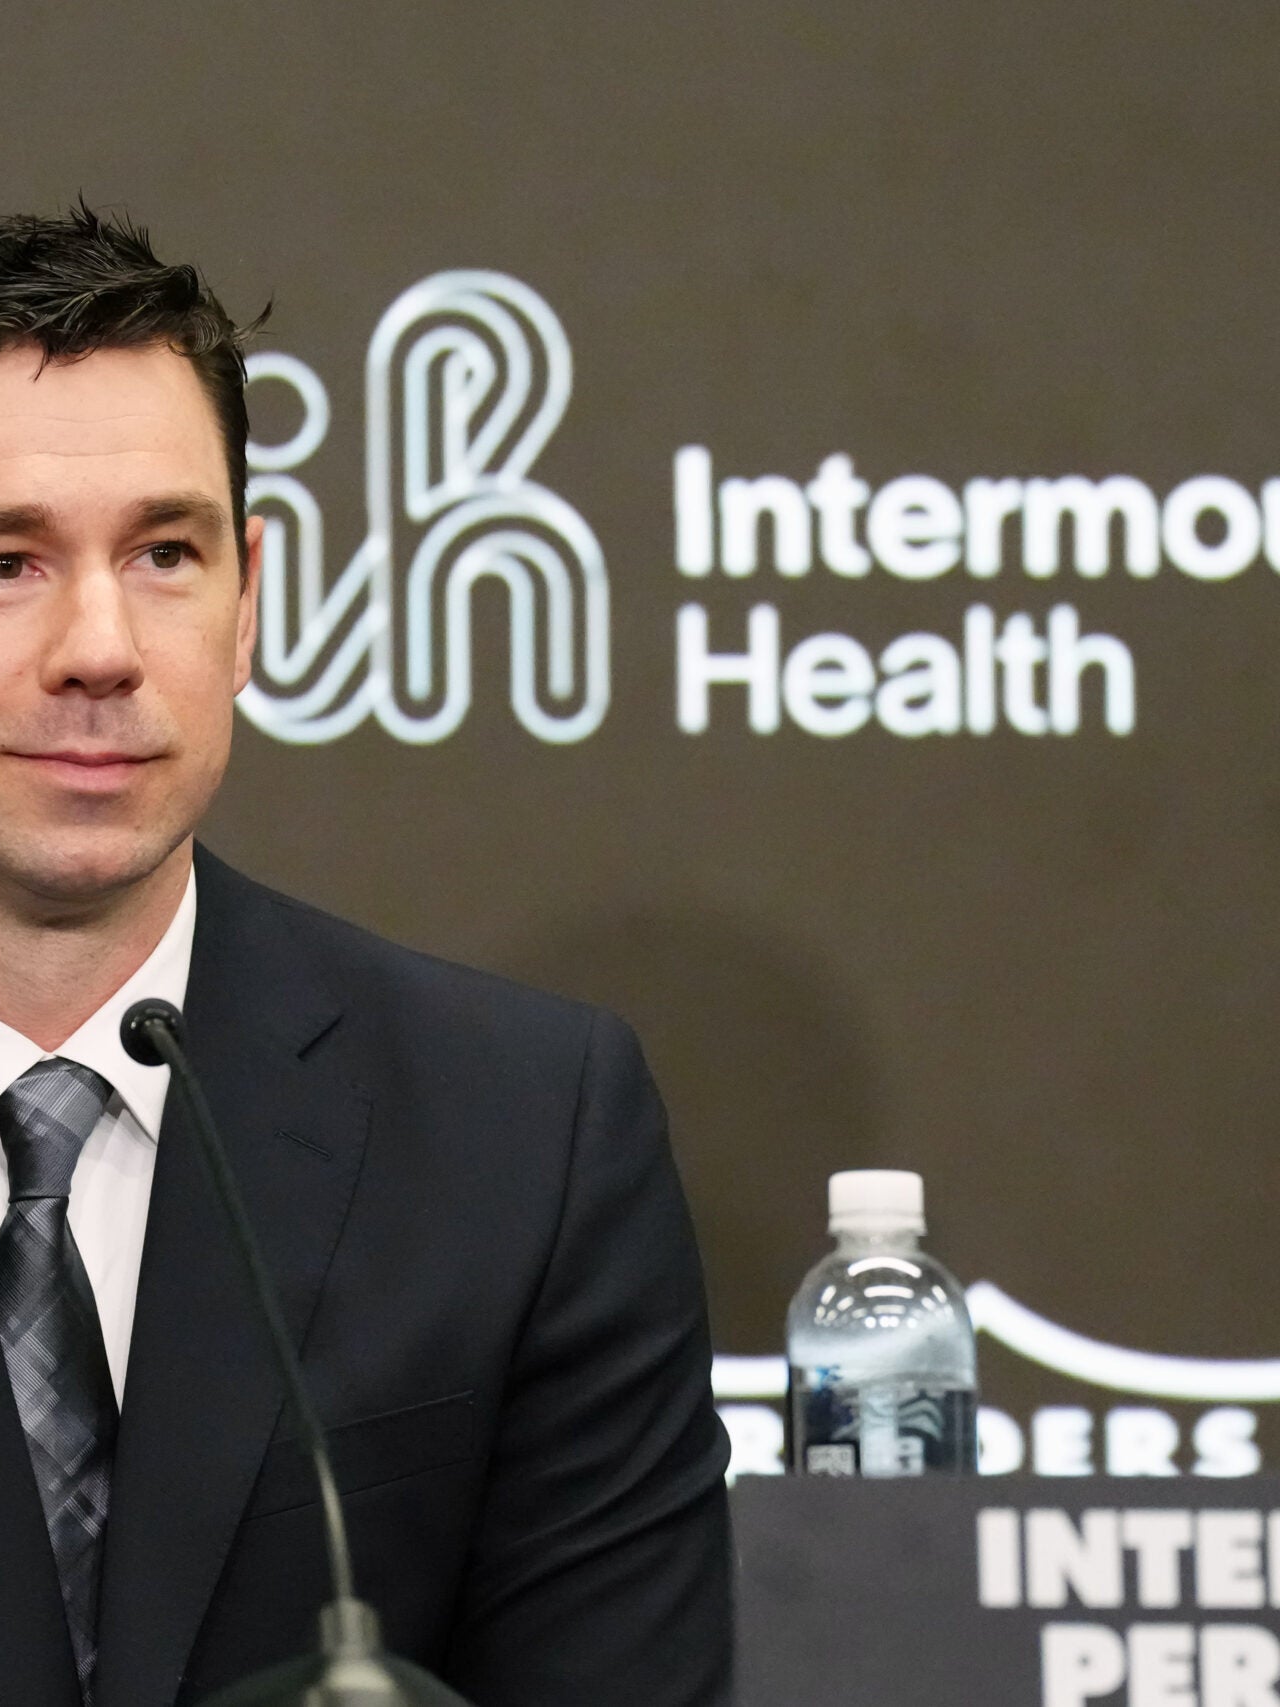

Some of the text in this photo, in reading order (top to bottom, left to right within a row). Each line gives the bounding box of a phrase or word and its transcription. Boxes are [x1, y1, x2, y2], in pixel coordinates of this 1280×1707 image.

[674, 445, 1280, 580] Intermo
[676, 603, 1135, 738] Health
[716, 1406, 1261, 1479] RDERS
[977, 1508, 1280, 1609] INTE
[1041, 1622, 1280, 1707] PER
